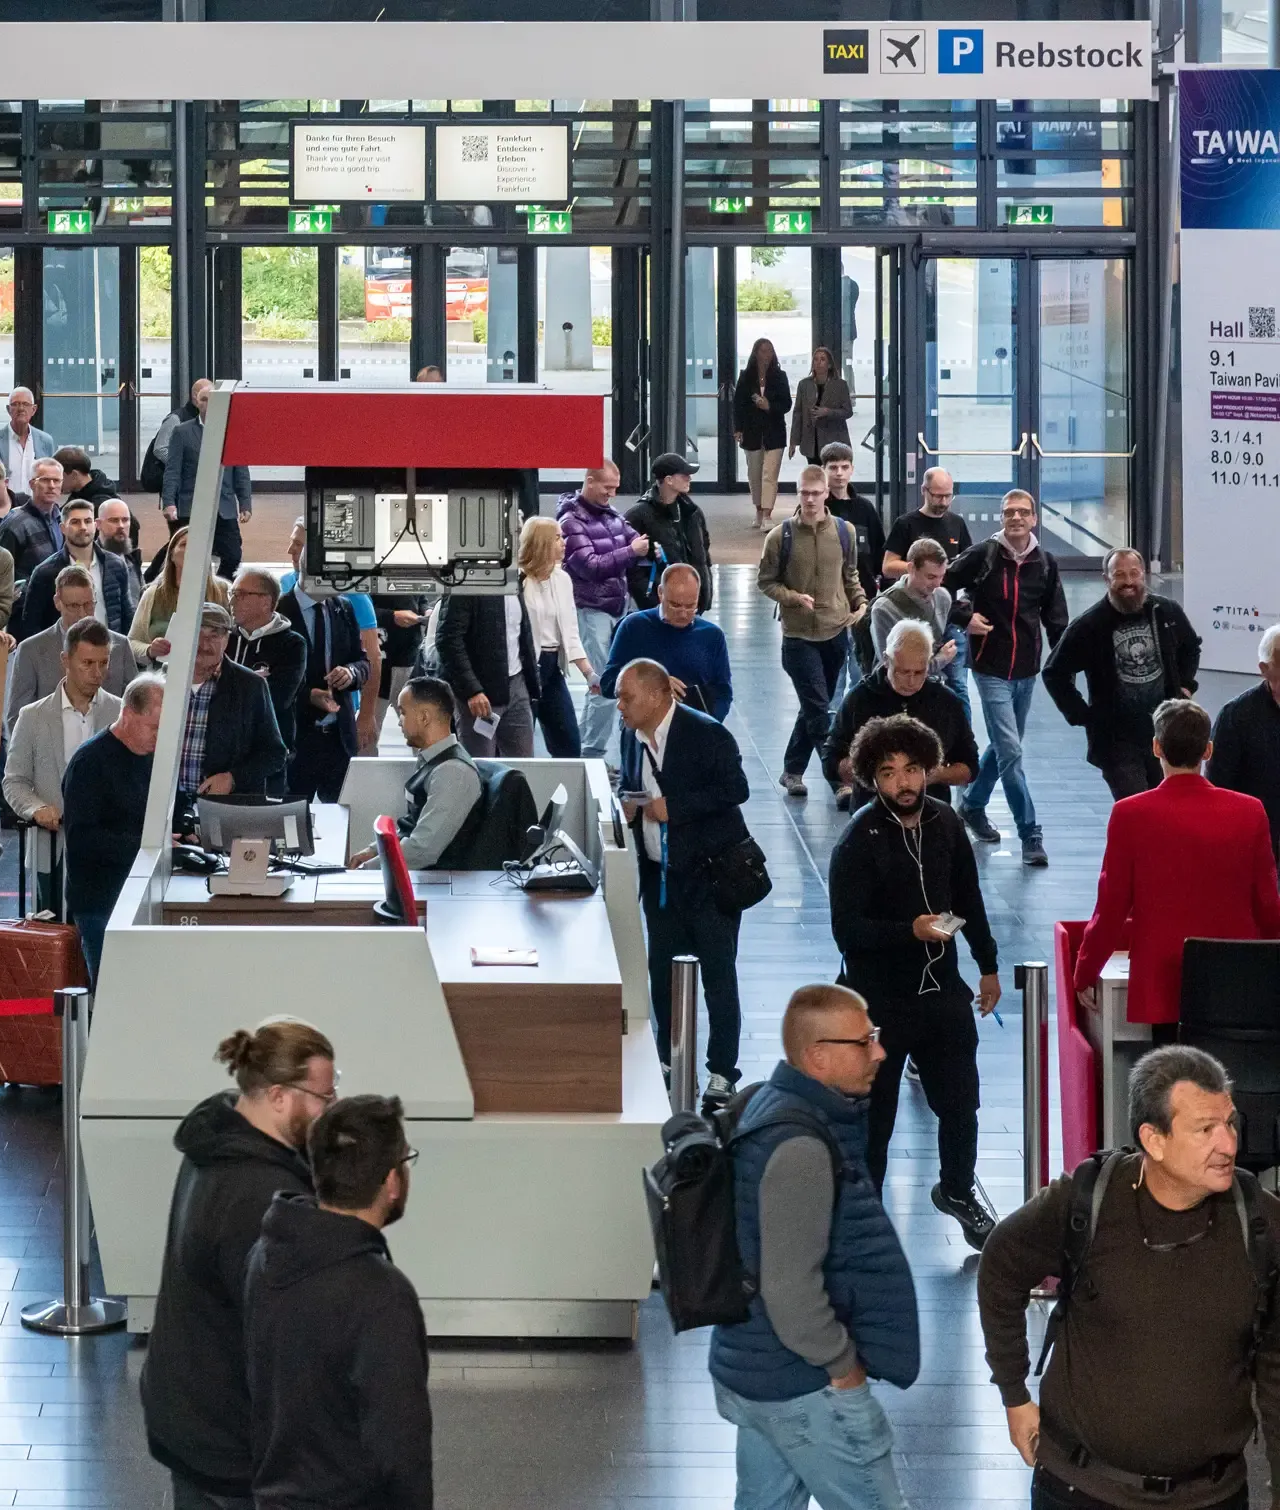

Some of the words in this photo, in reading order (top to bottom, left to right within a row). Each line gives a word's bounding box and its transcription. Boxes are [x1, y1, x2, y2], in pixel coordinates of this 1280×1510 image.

[826, 44, 864, 59] TAXI
[952, 36, 975, 66] P
[996, 41, 1144, 68] Rebstock
[305, 134, 330, 142] Danke
[1192, 130, 1280, 155] TAIWA
[340, 146, 359, 154] gute
[496, 144, 538, 152] Entdecken
[305, 155, 328, 163] Thank
[330, 157, 344, 165] you
[345, 155, 355, 163] for
[357, 157, 374, 165] your
[375, 155, 391, 163] visit
[496, 155, 526, 163] Erleben
[305, 165, 320, 173] and
[321, 165, 339, 173] have
[346, 165, 366, 175] good
[496, 165, 528, 173] Discover
[496, 175, 538, 184] Experience
[496, 185, 531, 193] Frankfurt
[1210, 320, 1244, 338] Hall
[1209, 349, 1235, 367] 9.1
[1210, 371, 1252, 387] Taiwan
[1210, 429, 1231, 444] 3.1
[1242, 431, 1263, 445] 4.1
[1210, 449, 1232, 465] 8.0
[1242, 451, 1264, 466] 9.0
[1211, 470, 1241, 486] 11.0
[1251, 473, 1280, 488] 11.1
[1225, 606, 1250, 616] TITA
[179, 915, 199, 927] 86
